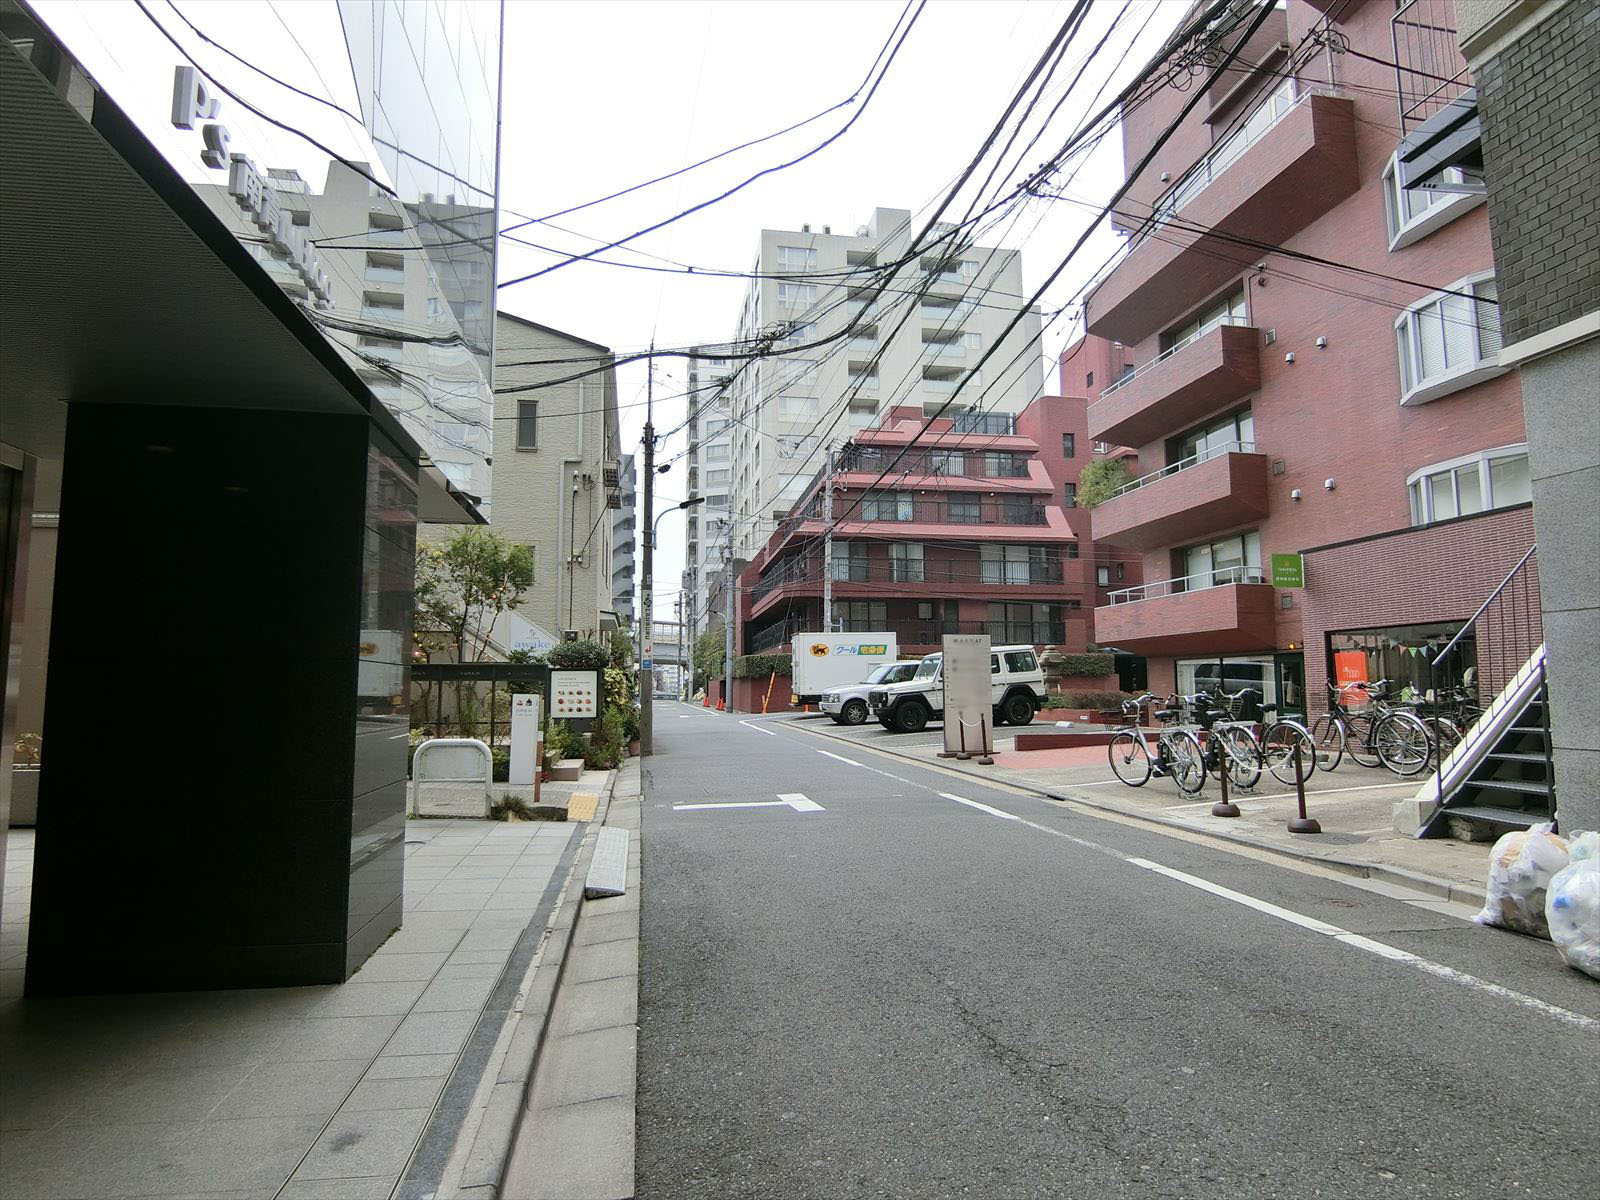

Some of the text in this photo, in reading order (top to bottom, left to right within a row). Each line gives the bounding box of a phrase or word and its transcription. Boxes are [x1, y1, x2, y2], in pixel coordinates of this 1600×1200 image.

[514, 639, 551, 649] awake
[836, 646, 858, 655] クール
